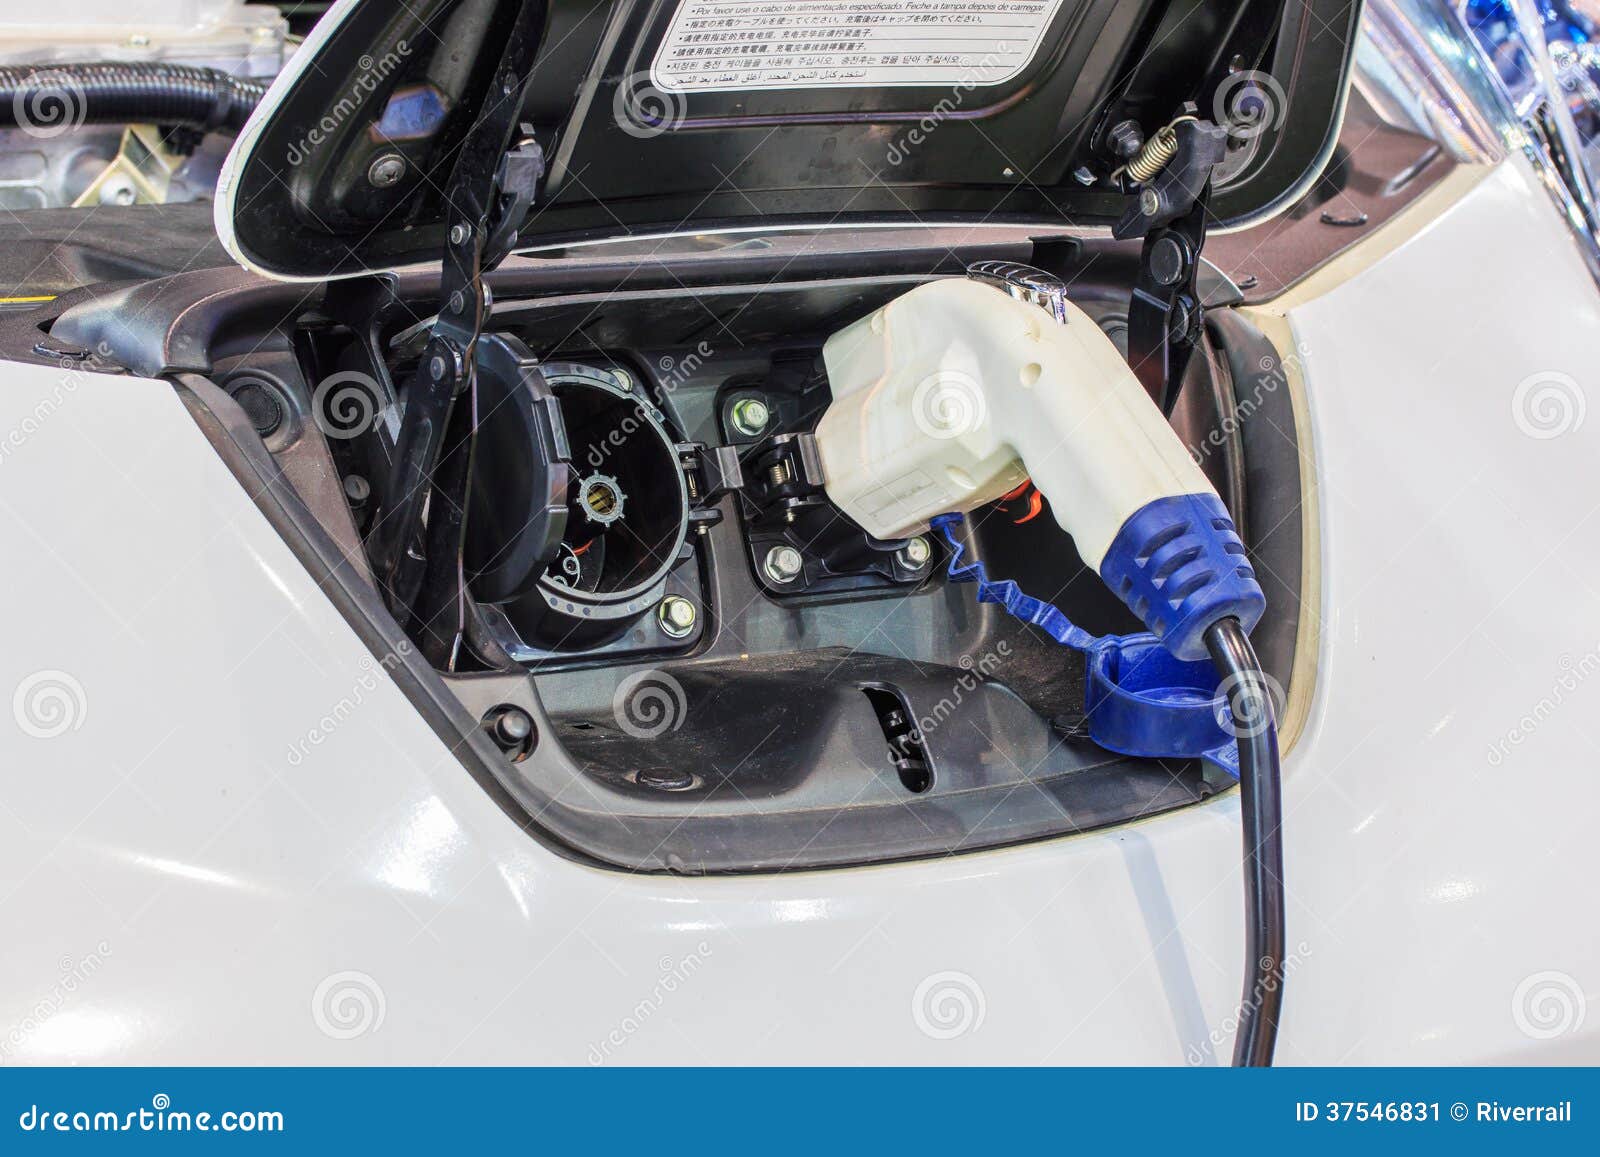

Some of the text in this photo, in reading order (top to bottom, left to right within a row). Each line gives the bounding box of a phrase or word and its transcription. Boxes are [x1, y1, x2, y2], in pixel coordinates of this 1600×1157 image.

[760, 4, 782, 13] cabo
[783, 4, 796, 12] de
[905, 2, 932, 10] Feche
[940, 3, 966, 11] tampa
[967, 3, 997, 11] depois
[997, 3, 1008, 11] de
